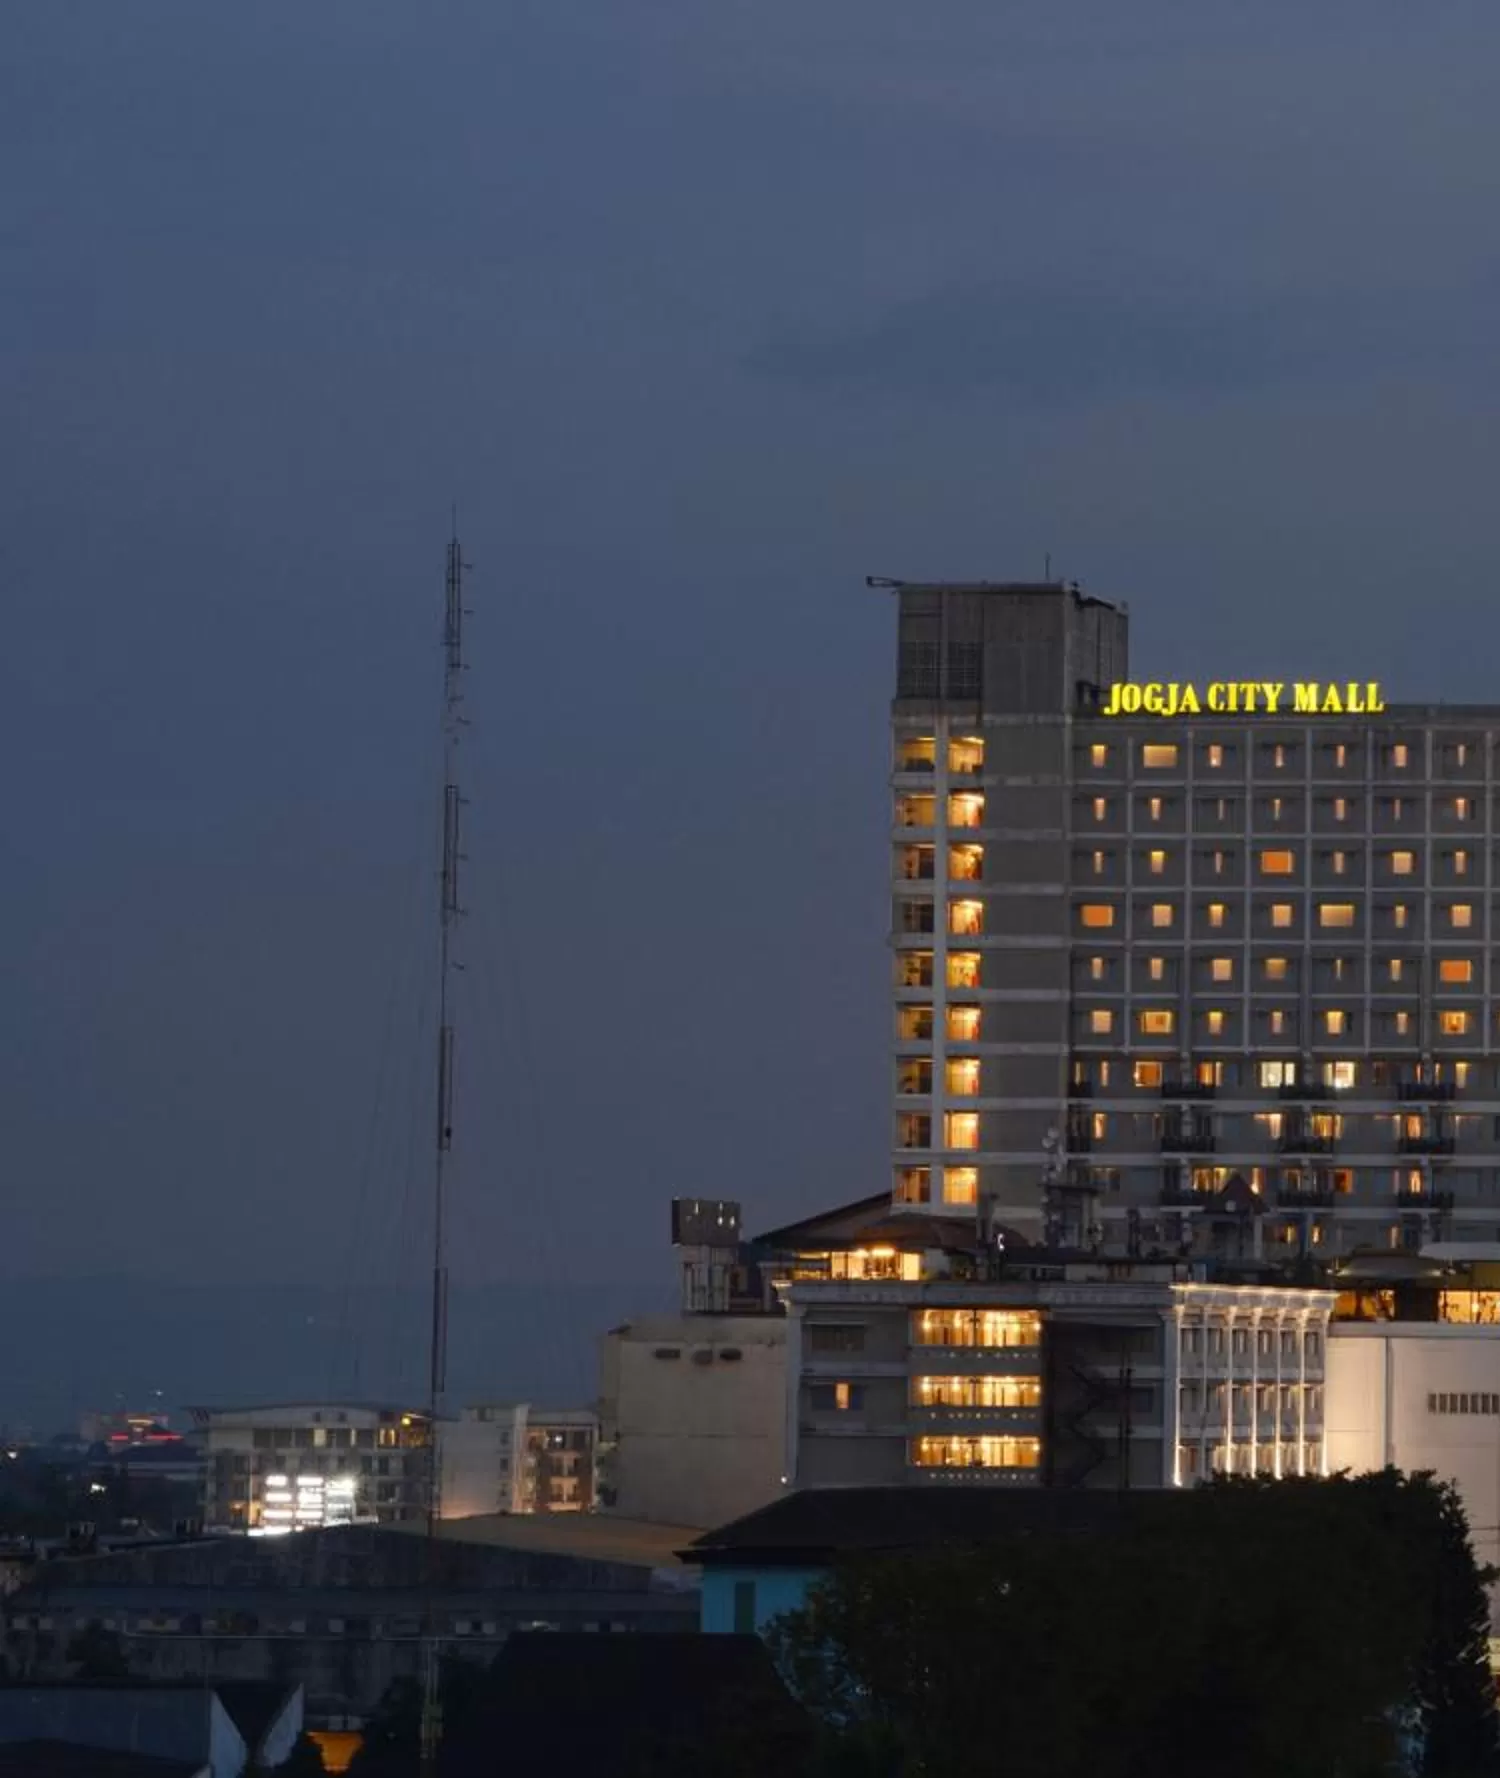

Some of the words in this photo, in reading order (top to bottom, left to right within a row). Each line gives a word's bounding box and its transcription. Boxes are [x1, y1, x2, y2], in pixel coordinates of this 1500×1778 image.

[1103, 682, 1201, 716] JOGJA
[1207, 682, 1284, 713] CITY
[1292, 682, 1385, 713] MALL
